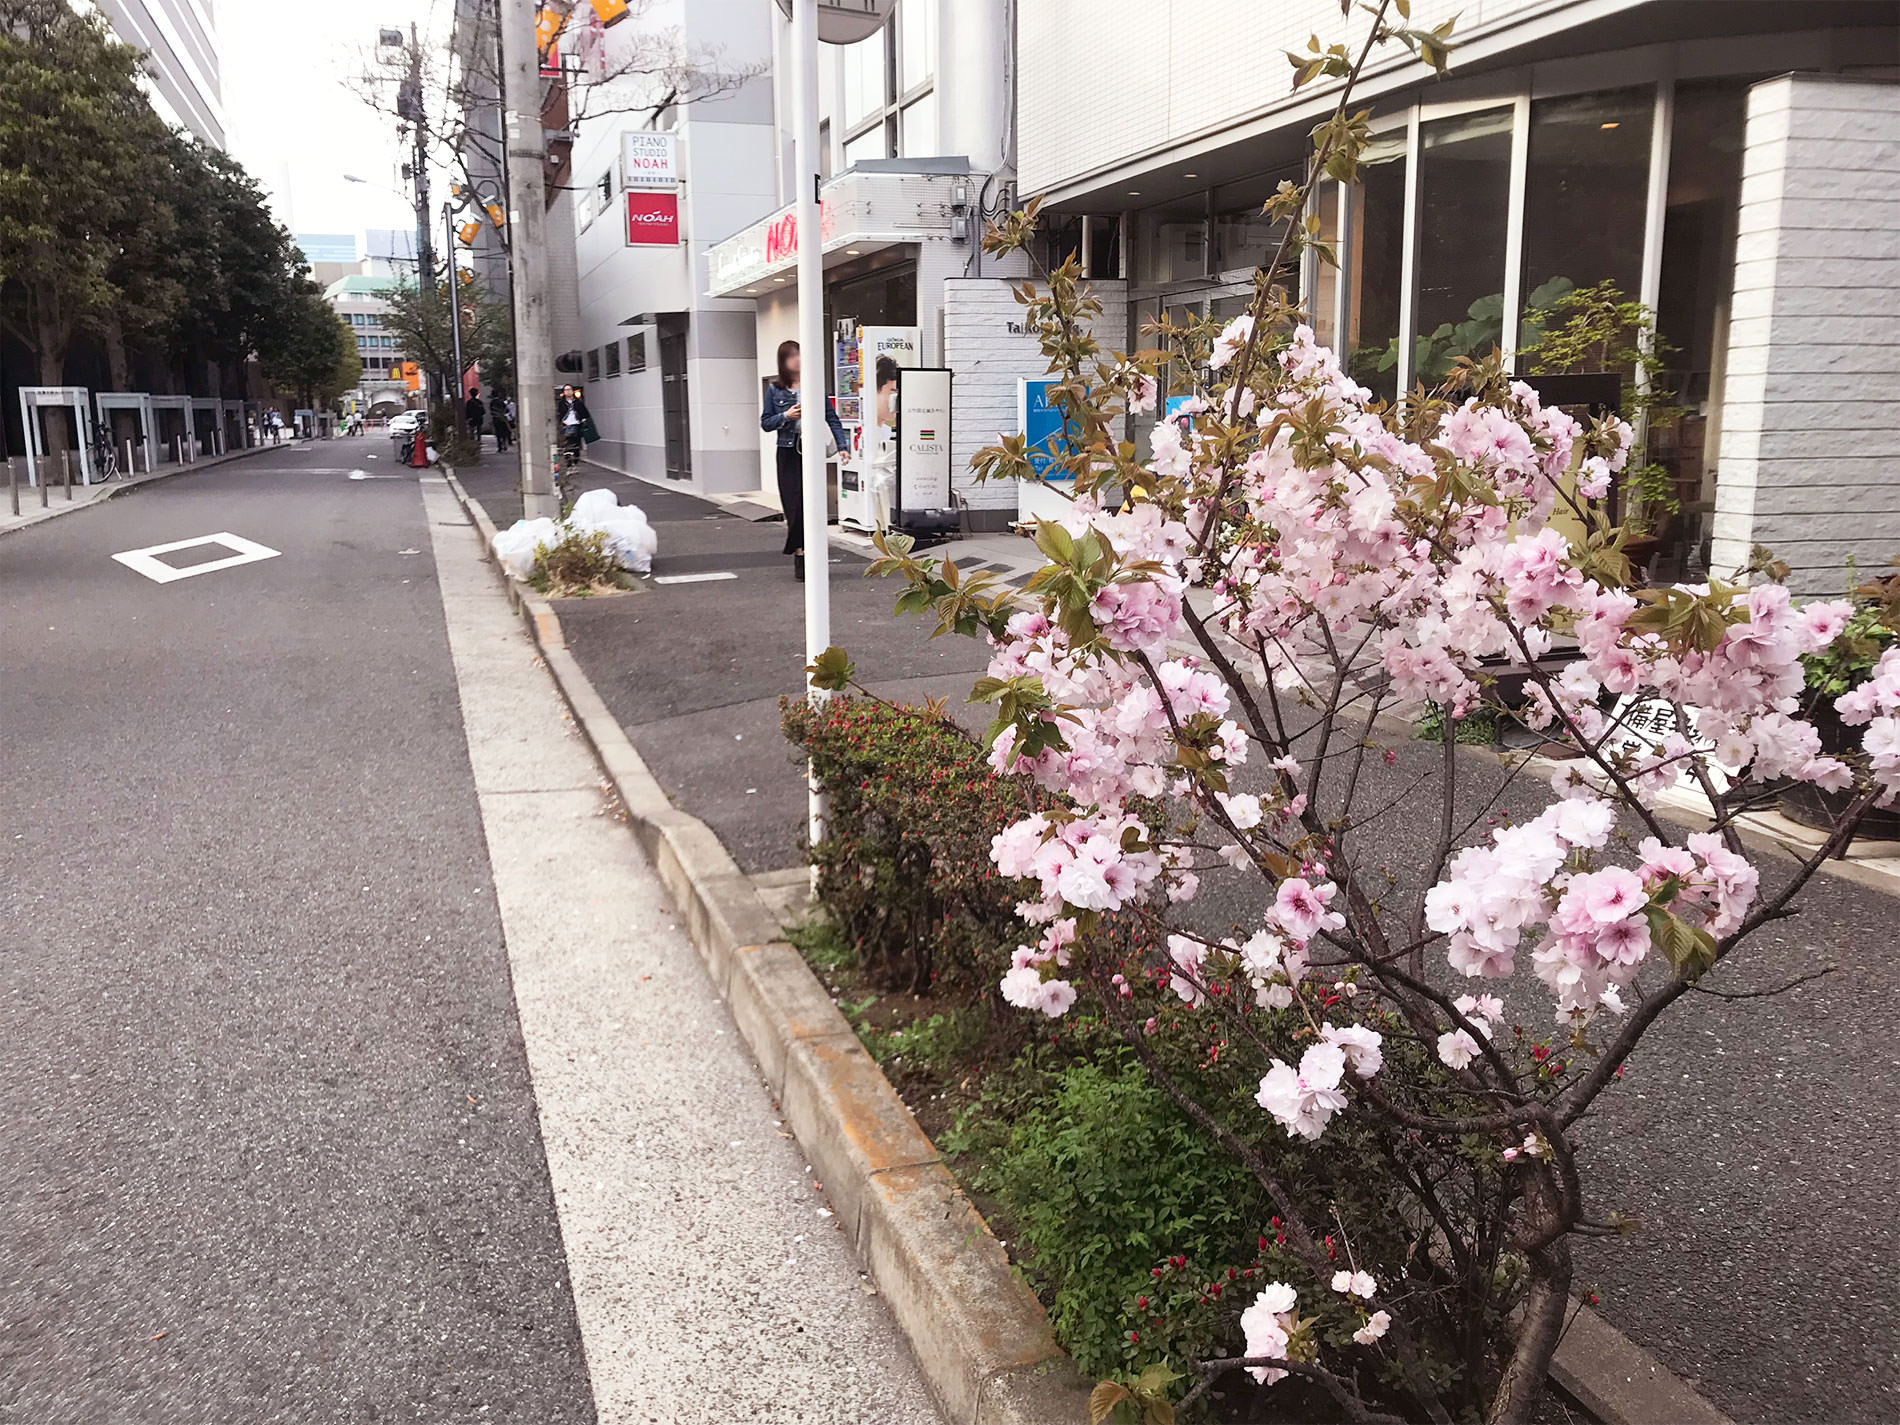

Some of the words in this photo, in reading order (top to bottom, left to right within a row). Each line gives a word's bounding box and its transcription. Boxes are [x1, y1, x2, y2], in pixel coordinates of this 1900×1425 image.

[632, 136, 668, 147] PIANO
[633, 147, 668, 157] STUDIO
[633, 158, 668, 168] NOAH
[631, 211, 674, 223] NOAH
[877, 342, 914, 351] EUROPEAN
[909, 444, 944, 452] CALISTA
[1553, 508, 1569, 516] Hair
